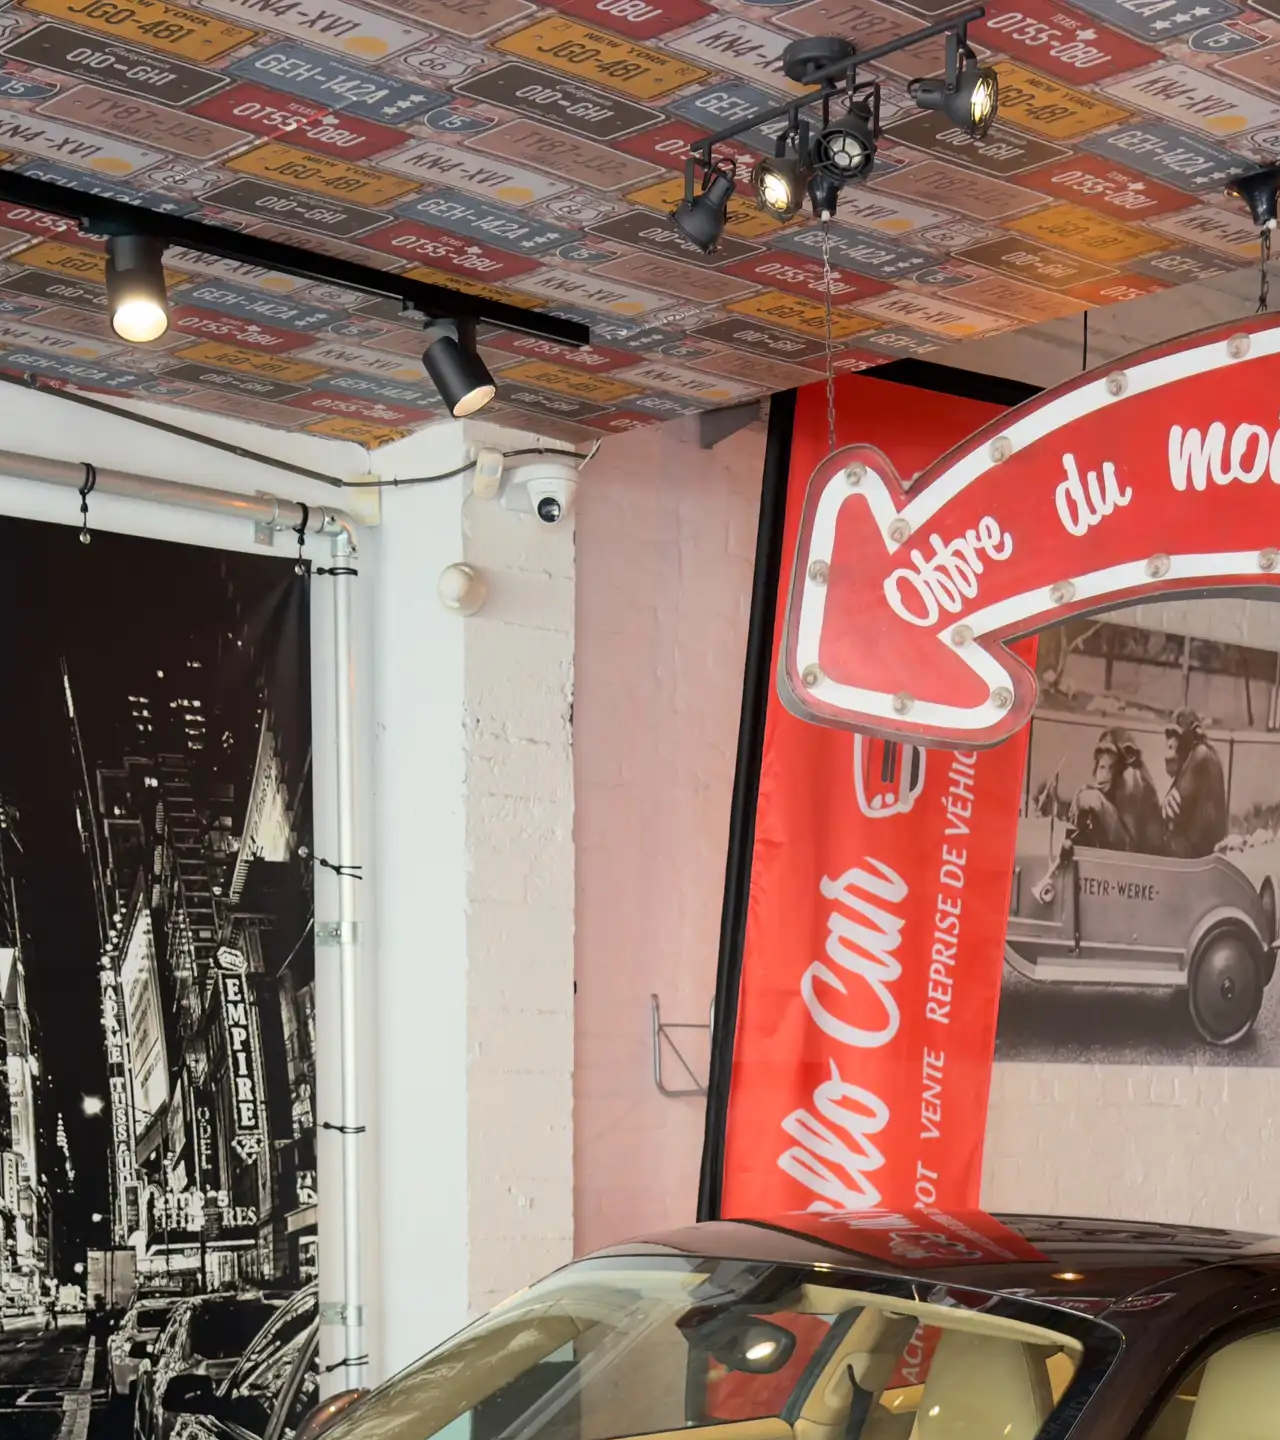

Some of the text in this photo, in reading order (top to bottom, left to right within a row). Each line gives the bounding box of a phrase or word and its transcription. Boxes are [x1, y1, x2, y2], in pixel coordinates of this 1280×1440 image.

[1201, 31, 1239, 48] 15
[0, 79, 31, 94] 15
[256, 53, 386, 104] GEH-142A
[1128, 75, 1239, 117] KN4-XV1
[436, 114, 469, 128] 15
[400, 152, 512, 188] KN4-XV1
[1108, 129, 1211, 173] GEH-142A
[418, 199, 527, 237] GEH-142A
[794, 229, 892, 265] GEH-142A
[531, 276, 628, 303] KN4-XV1
[922, 272, 952, 282] 15
[194, 287, 297, 319] GEH-142A
[875, 299, 965, 325] KN4-XV1
[667, 347, 693, 355] 15
[884, 515, 1013, 627] Offre
[1055, 453, 1133, 537] du
[941, 749, 980, 837] VÉHIC
[940, 843, 968, 890] DE
[925, 893, 962, 1025] REPRISE
[777, 855, 910, 1211] llo Car
[225, 977, 256, 1128] EMPIRE
[919, 1046, 946, 1140] VENTE
